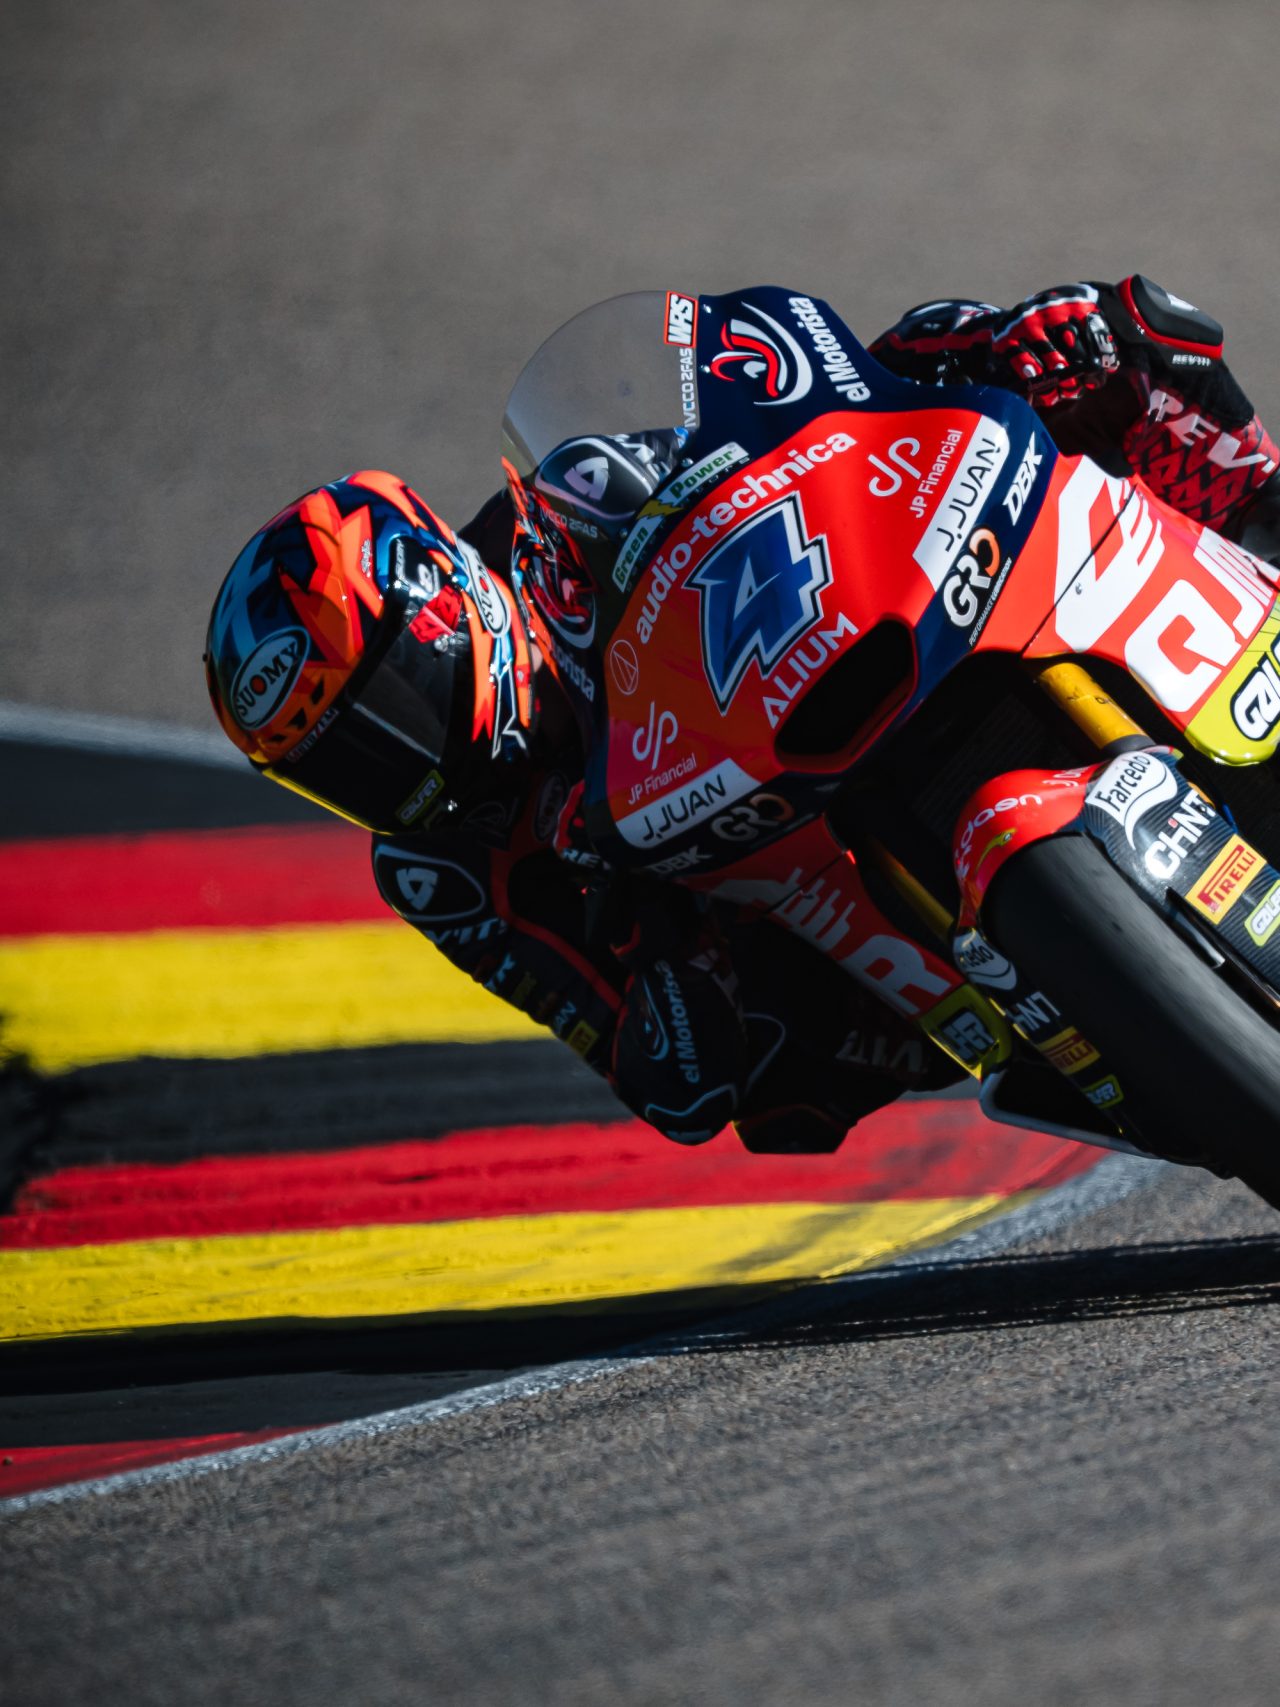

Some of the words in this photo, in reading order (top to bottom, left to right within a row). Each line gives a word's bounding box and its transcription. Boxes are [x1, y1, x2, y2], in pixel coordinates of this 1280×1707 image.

[667, 294, 695, 346] WRS
[788, 296, 860, 383] Motorista
[917, 428, 964, 495] Financial
[935, 437, 1001, 553] J.JUAN
[1001, 431, 1044, 527] DBK
[614, 525, 649, 586] Green
[668, 449, 735, 500] Power
[635, 431, 858, 645] audio-technica
[908, 494, 928, 519] JP
[682, 489, 833, 717] 4
[235, 640, 300, 718] SUOMY
[762, 611, 860, 729] ALIUM
[642, 773, 728, 843] J.JUAN
[644, 752, 698, 795] Financial
[1094, 754, 1151, 813] Farcedo
[1197, 844, 1258, 915] PIRELLI
